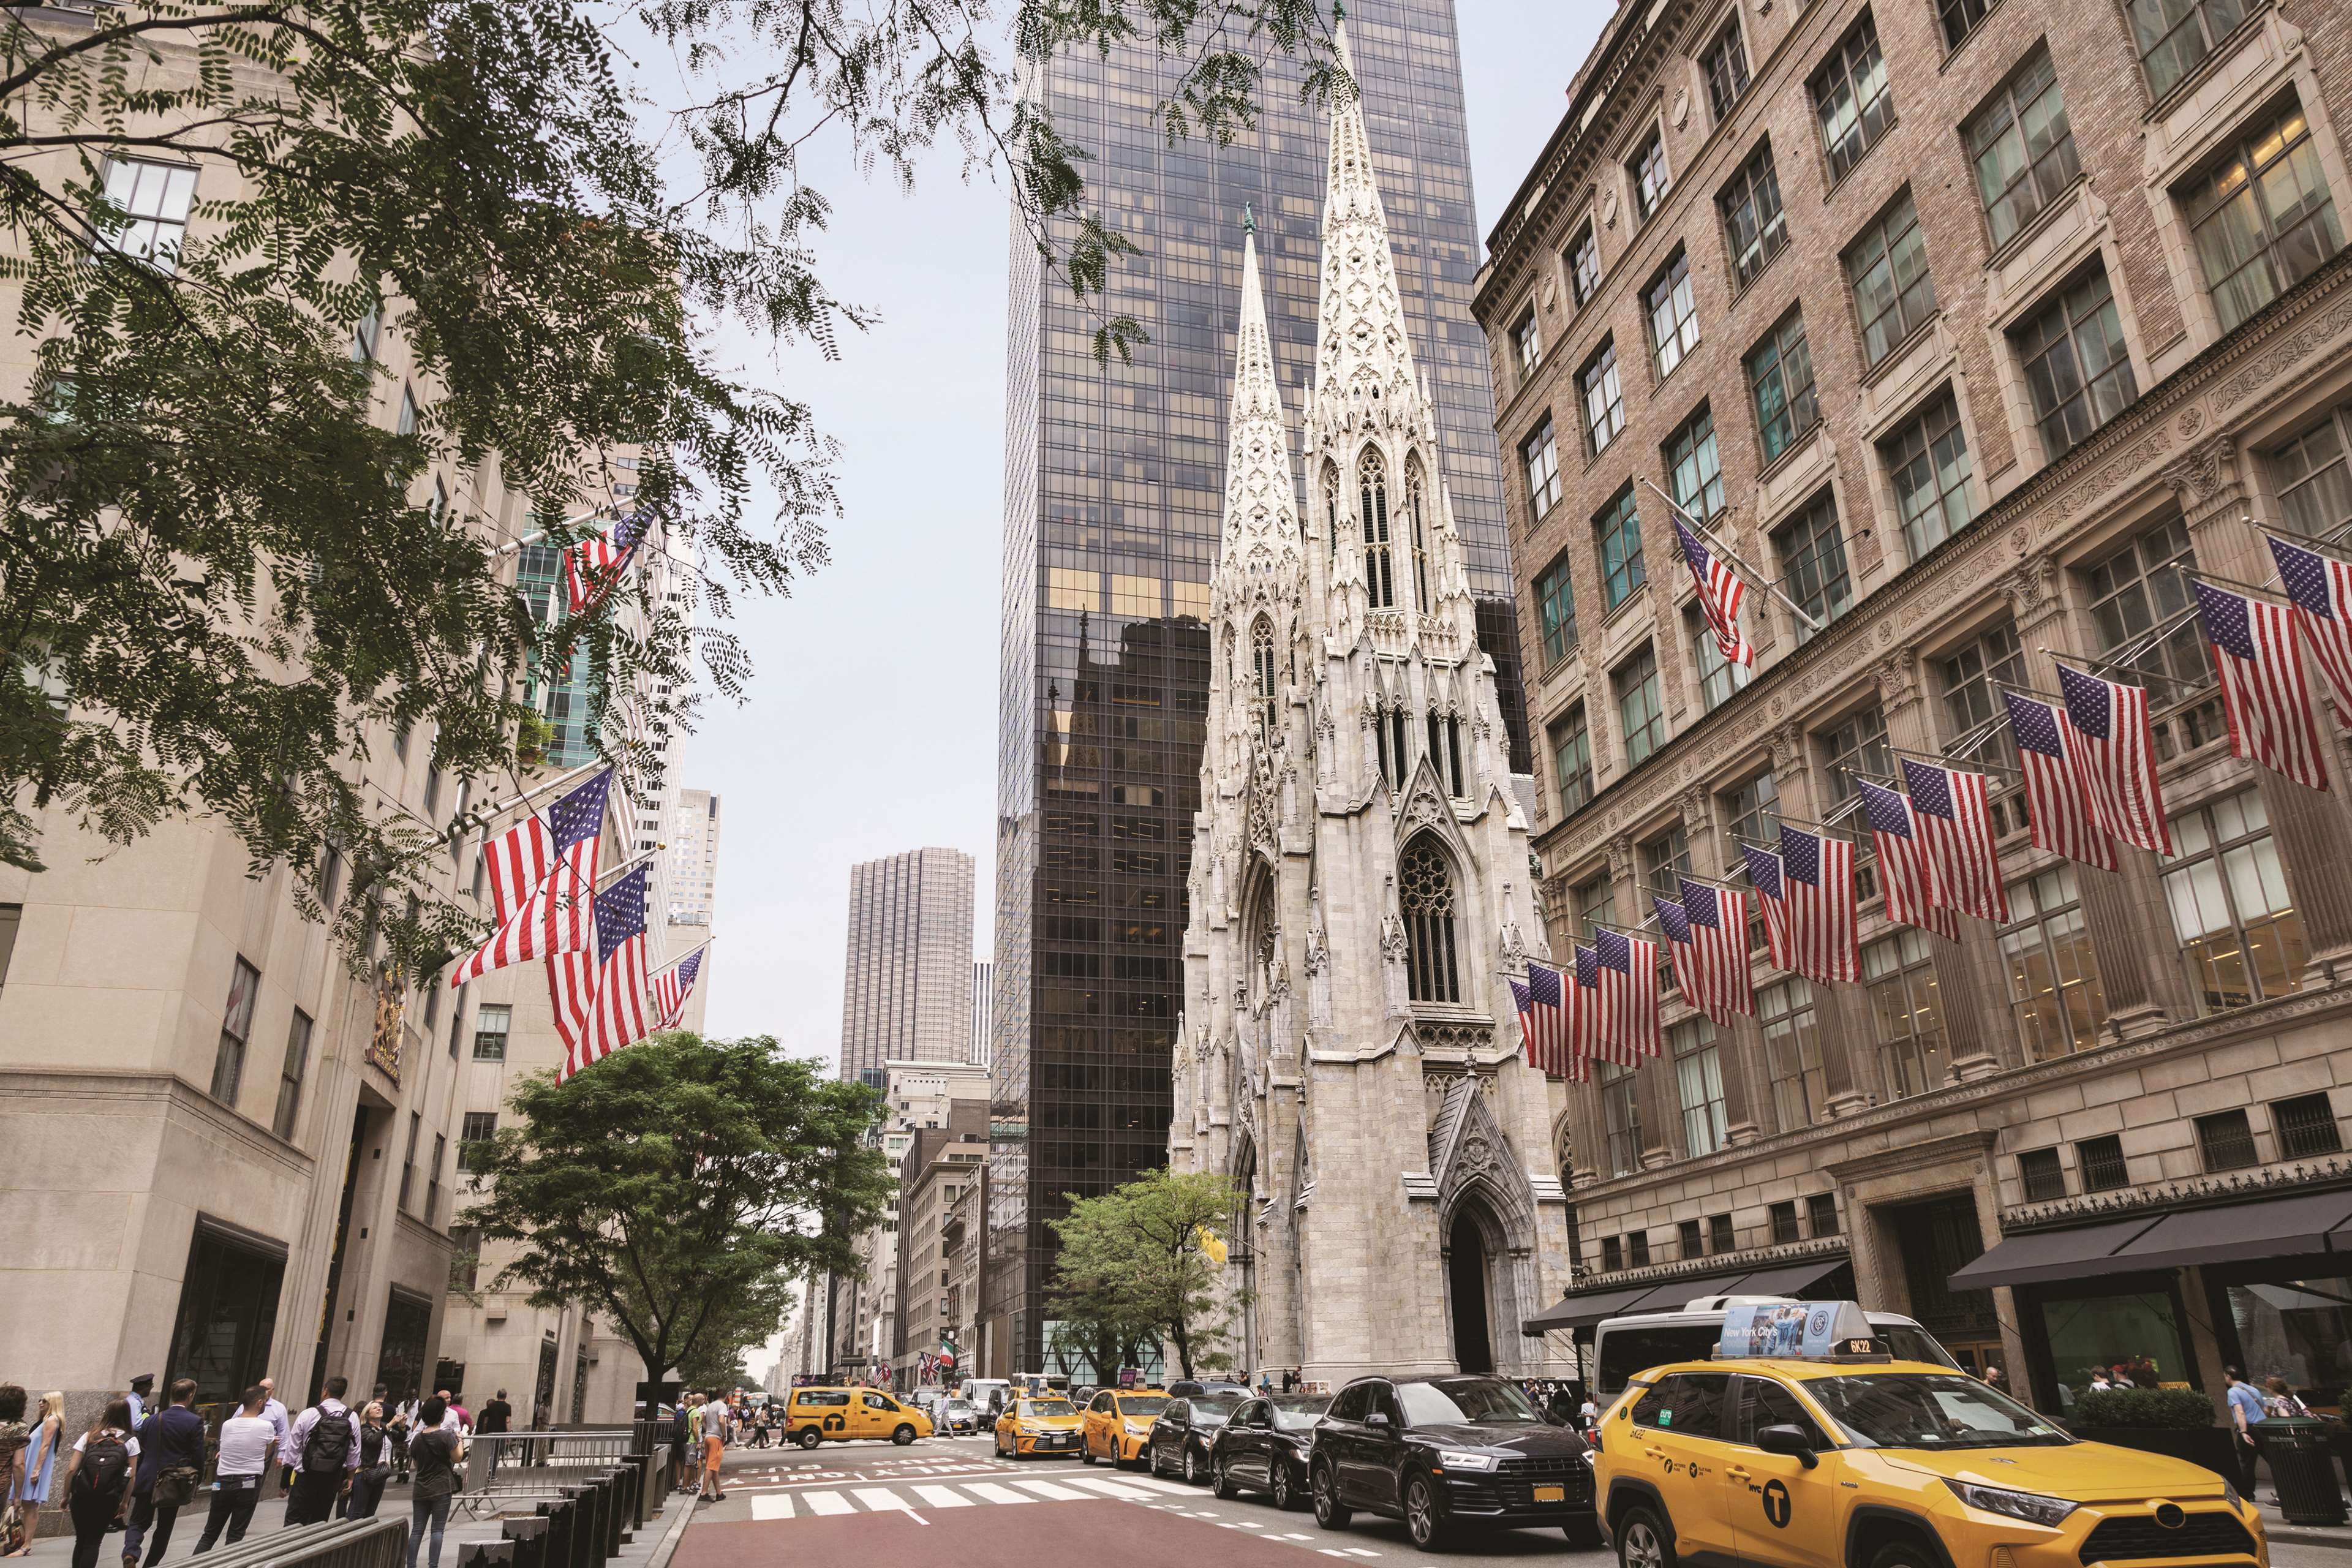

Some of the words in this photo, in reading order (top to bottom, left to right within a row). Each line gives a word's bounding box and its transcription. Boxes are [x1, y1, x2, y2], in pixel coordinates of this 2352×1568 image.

[1724, 1327, 1740, 1337] New
[1741, 1327, 1757, 1336] York
[1758, 1326, 1778, 1338] City's
[1850, 1340, 1871, 1353] 6K22
[871, 1457, 955, 1467] BUS
[739, 1463, 822, 1474] BUS
[875, 1463, 997, 1477] ONLY
[722, 1471, 846, 1485] ONLY
[1749, 1483, 1762, 1494] NYC
